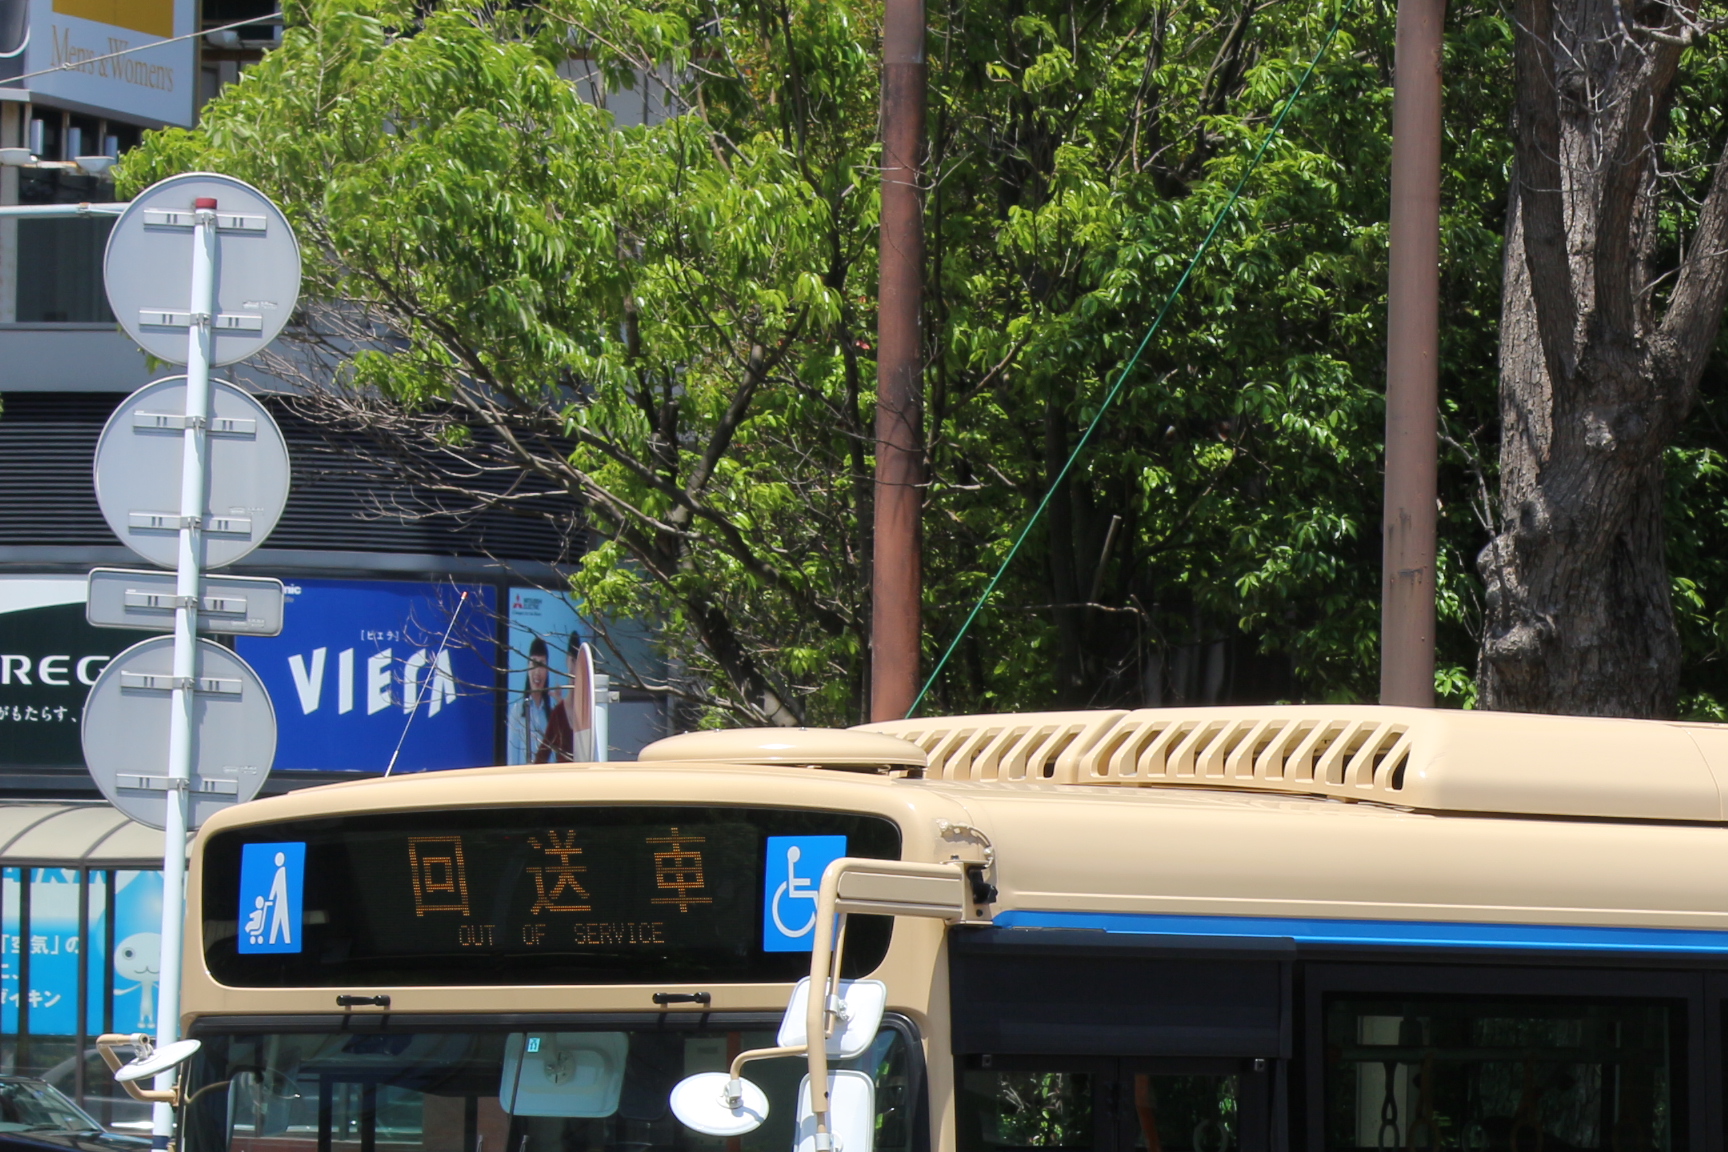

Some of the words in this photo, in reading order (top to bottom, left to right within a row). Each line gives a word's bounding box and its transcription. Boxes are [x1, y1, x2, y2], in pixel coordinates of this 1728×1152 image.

[407, 826, 713, 918] 回送車
[459, 924, 496, 946] OUT
[522, 924, 546, 945] OF
[574, 922, 665, 945] SERVICE
